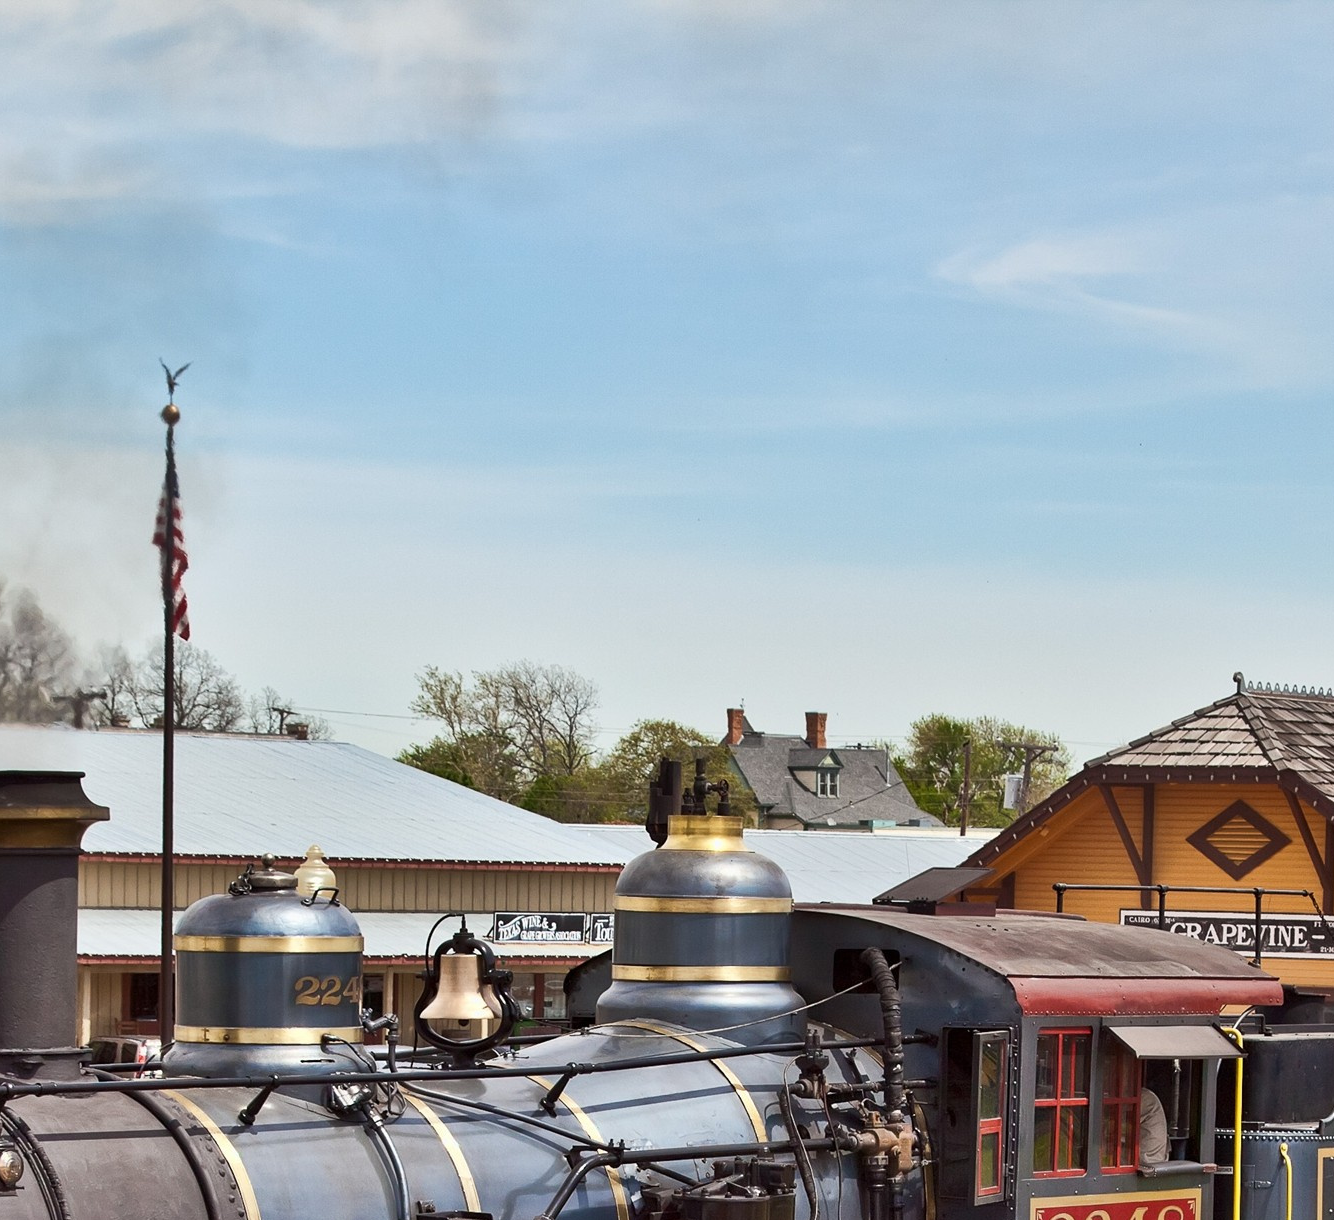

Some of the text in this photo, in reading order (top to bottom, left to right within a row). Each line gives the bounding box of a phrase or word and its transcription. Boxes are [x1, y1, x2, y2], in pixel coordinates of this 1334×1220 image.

[498, 918, 522, 940] TEXAS
[521, 915, 542, 930] WINE
[1129, 916, 1151, 924] CAIRO
[1170, 922, 1308, 947] GRAPEVINE
[294, 975, 363, 1006] 224
